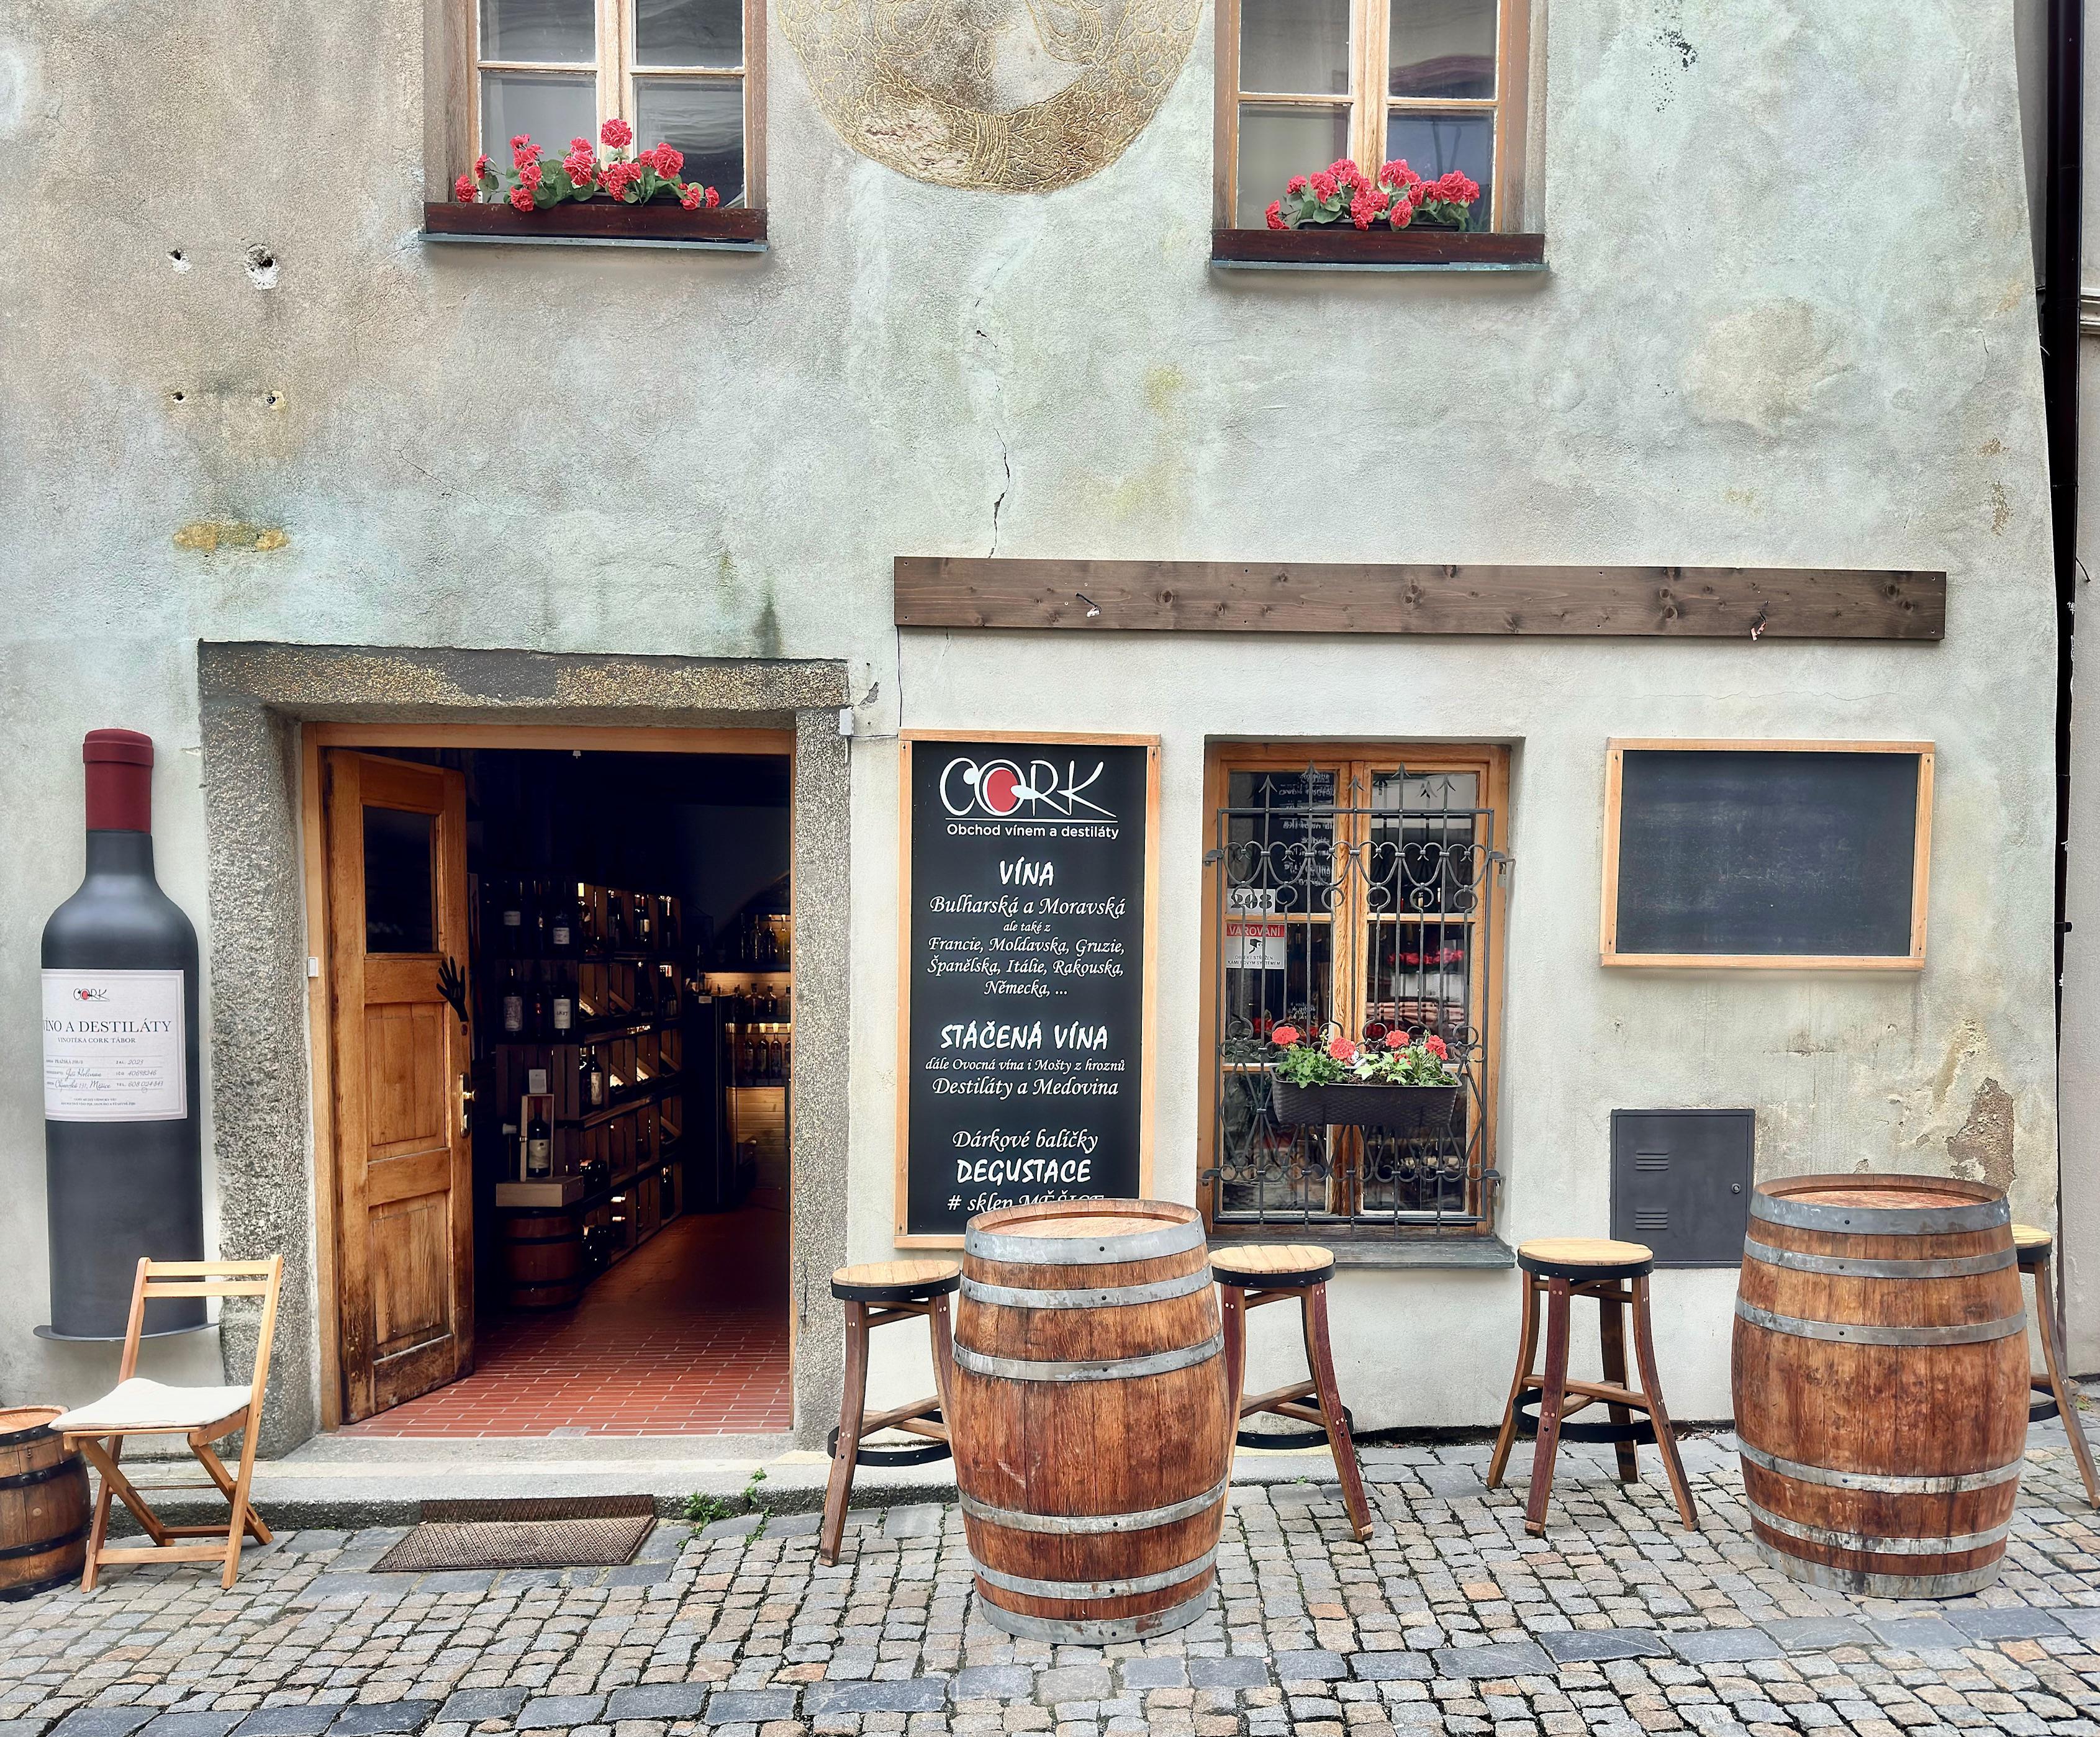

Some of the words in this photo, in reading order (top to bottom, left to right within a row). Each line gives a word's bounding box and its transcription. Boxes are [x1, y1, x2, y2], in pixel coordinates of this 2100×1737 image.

[939, 757, 1118, 817] CORK
[946, 824, 1001, 836] Obchod
[1005, 824, 1046, 837] vínem
[1049, 829, 1057, 837] a
[1061, 826, 1120, 840] destiláty
[1000, 856, 1054, 887] VÍNA
[930, 895, 1019, 918] Bulharská
[1023, 900, 1034, 914] a
[1039, 897, 1126, 919] Moravská
[1003, 921, 1019, 932] ale
[1020, 922, 1043, 934] také
[1044, 923, 1051, 933] z
[1229, 926, 1280, 937] VAROVÁNÍ
[928, 937, 984, 953] Francie,
[989, 937, 1070, 955] Moldavska,
[1075, 939, 1125, 955] Gruzie,
[927, 955, 1001, 977] Španělska,
[1007, 959, 1048, 975] Itálie,
[1052, 960, 1124, 977] Rakouska,
[73, 988, 110, 1001] CORK
[984, 980, 1050, 999] Německa,
[66, 1022, 75, 1032] A
[79, 1018, 171, 1033] DESTILÁTY
[940, 1019, 1043, 1051] STÁČENÁ
[1054, 1021, 1108, 1051] VÍNA
[925, 1057, 949, 1070] dále
[952, 1058, 996, 1070] Ovocná
[998, 1058, 1025, 1071] vína
[1027, 1059, 1032, 1070] i
[1034, 1058, 1072, 1075] Mošty
[1074, 1062, 1082, 1072] z
[1085, 1058, 1126, 1072] hroznů
[932, 1076, 1013, 1100] Destiláty
[1017, 1081, 1027, 1094] a
[1032, 1076, 1118, 1096] Medovina
[952, 1128, 1031, 1153] Dárkové
[1035, 1130, 1098, 1155] balíčky
[956, 1158, 1091, 1186] DEGUSTACE
[947, 1194, 962, 1211] #
